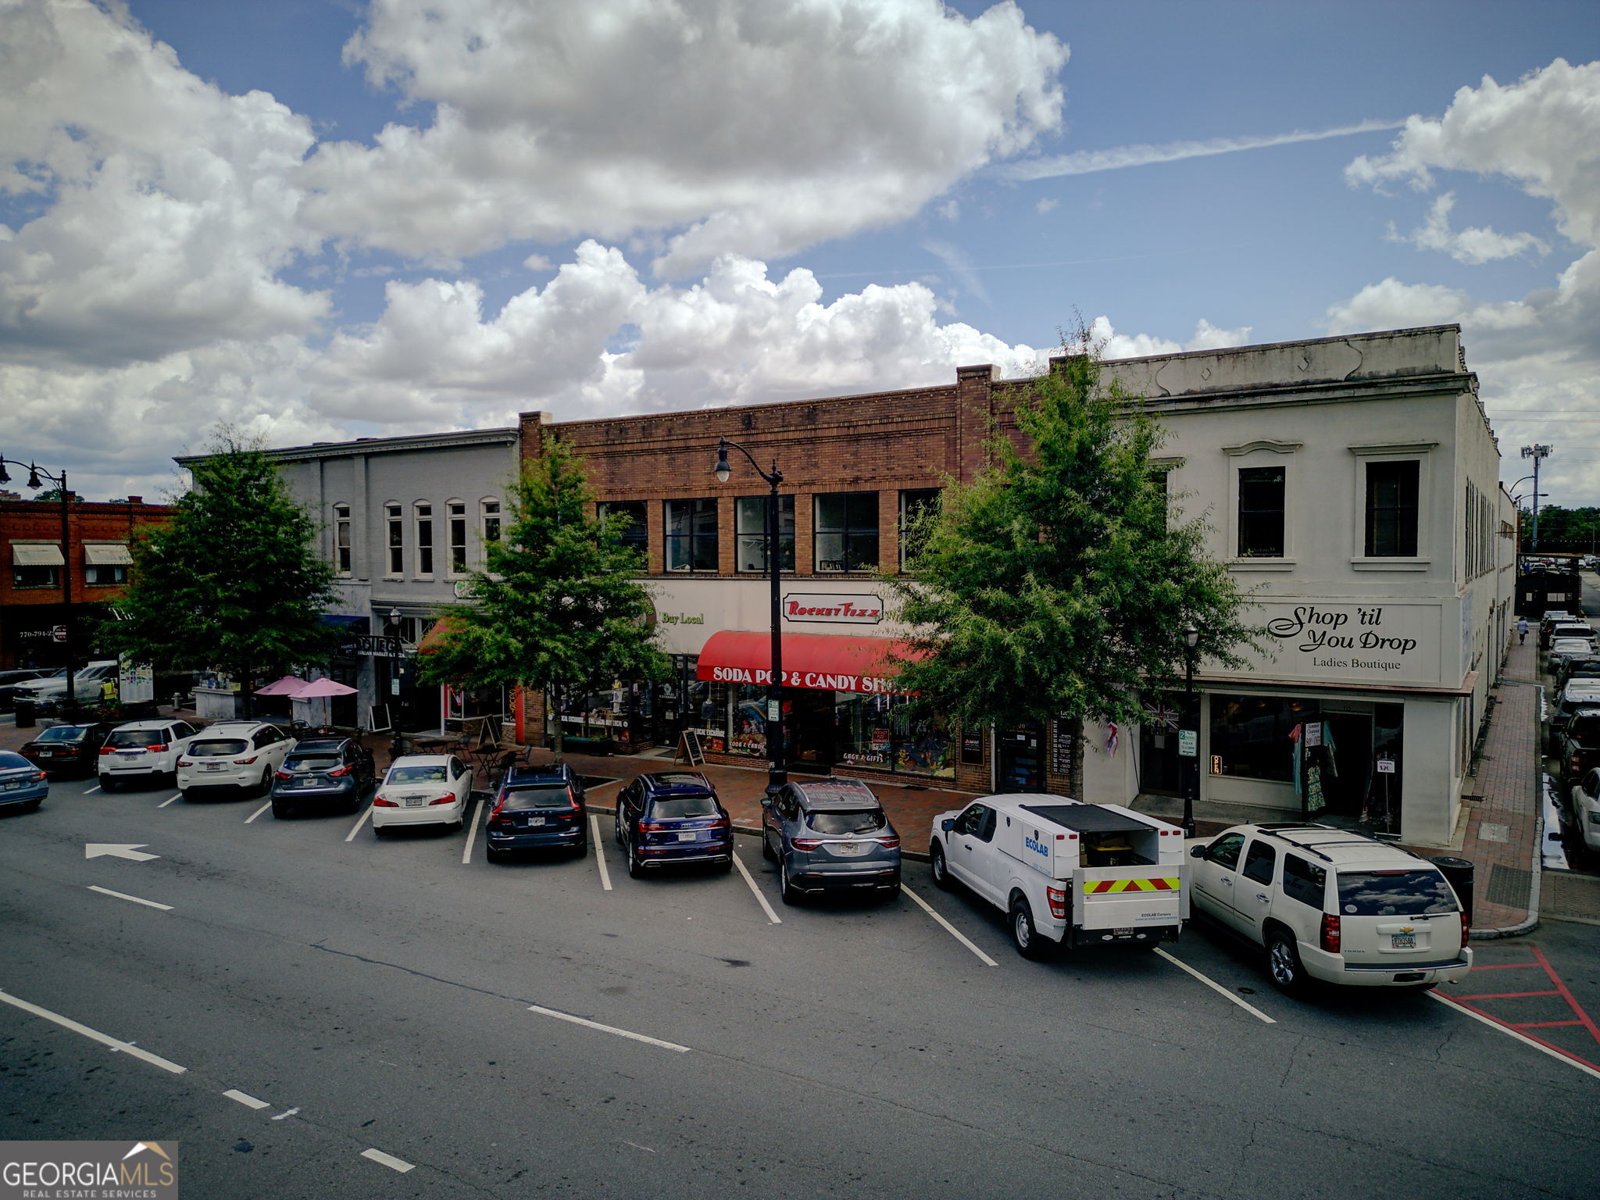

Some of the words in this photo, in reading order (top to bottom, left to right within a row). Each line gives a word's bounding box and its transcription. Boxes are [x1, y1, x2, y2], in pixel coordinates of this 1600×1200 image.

[661, 612, 680, 626] Buy
[680, 612, 704, 625] Local
[1267, 606, 1348, 638] Shop
[1299, 629, 1355, 653] You
[1359, 630, 1417, 655] Drop
[1313, 656, 1348, 668] Ladies
[1351, 658, 1401, 671] Boutique
[713, 666, 753, 683] SODA
[791, 671, 801, 686] &
[804, 672, 858, 691] CANDY
[1025, 836, 1049, 858] ECOLAB
